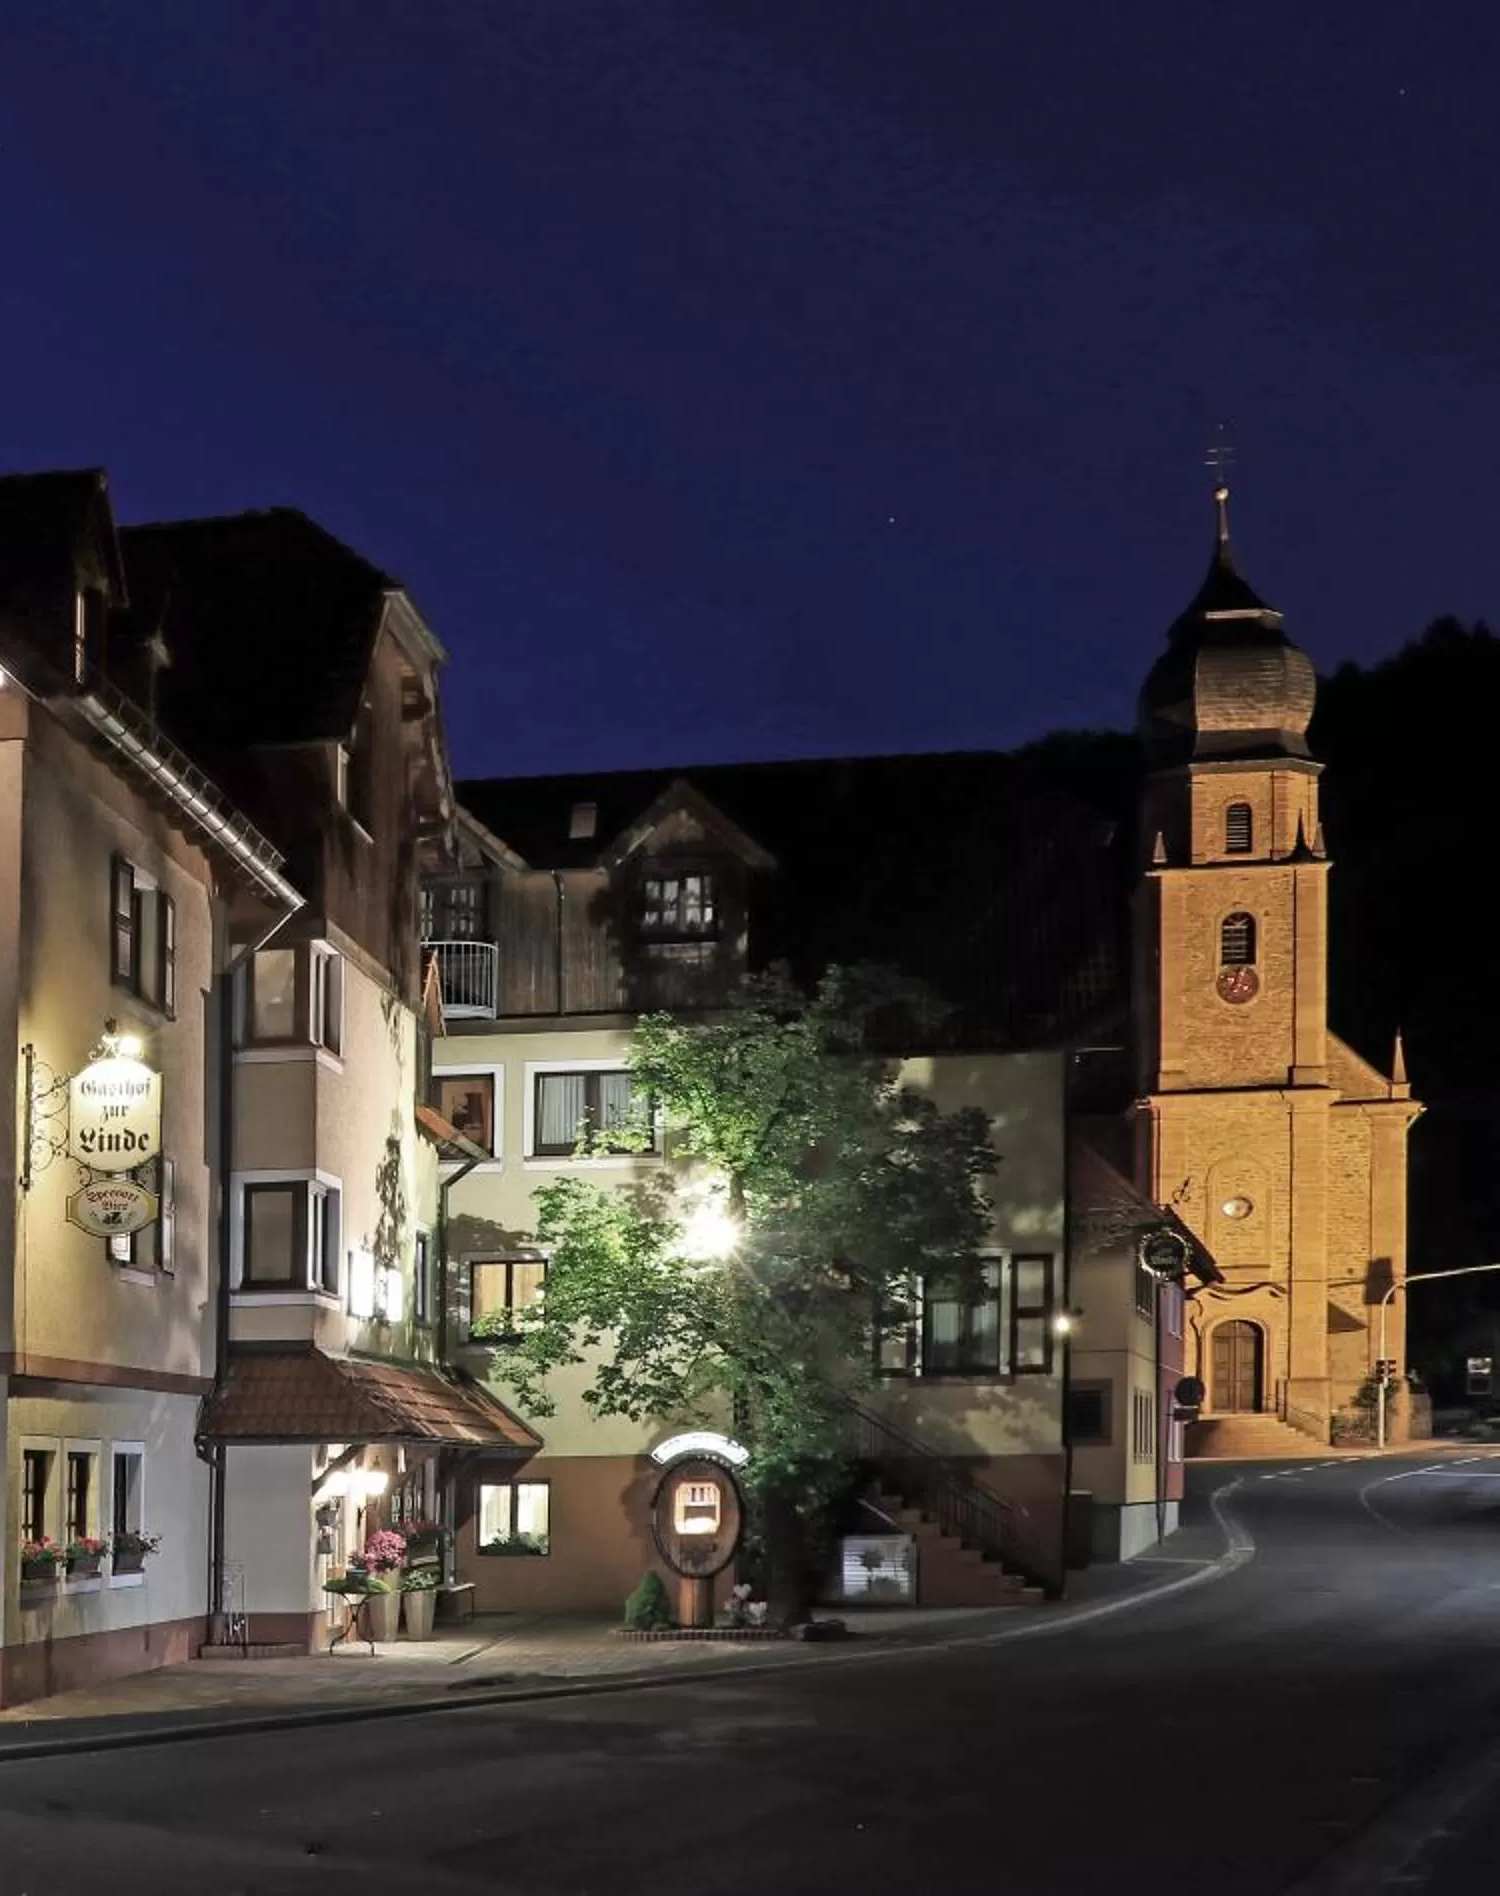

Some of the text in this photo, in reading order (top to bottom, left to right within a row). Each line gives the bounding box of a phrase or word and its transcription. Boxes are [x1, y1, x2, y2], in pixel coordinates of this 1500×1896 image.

[80, 1078, 151, 1100] Gasthof
[101, 1104, 129, 1123] zur
[79, 1127, 150, 1152] Linde
